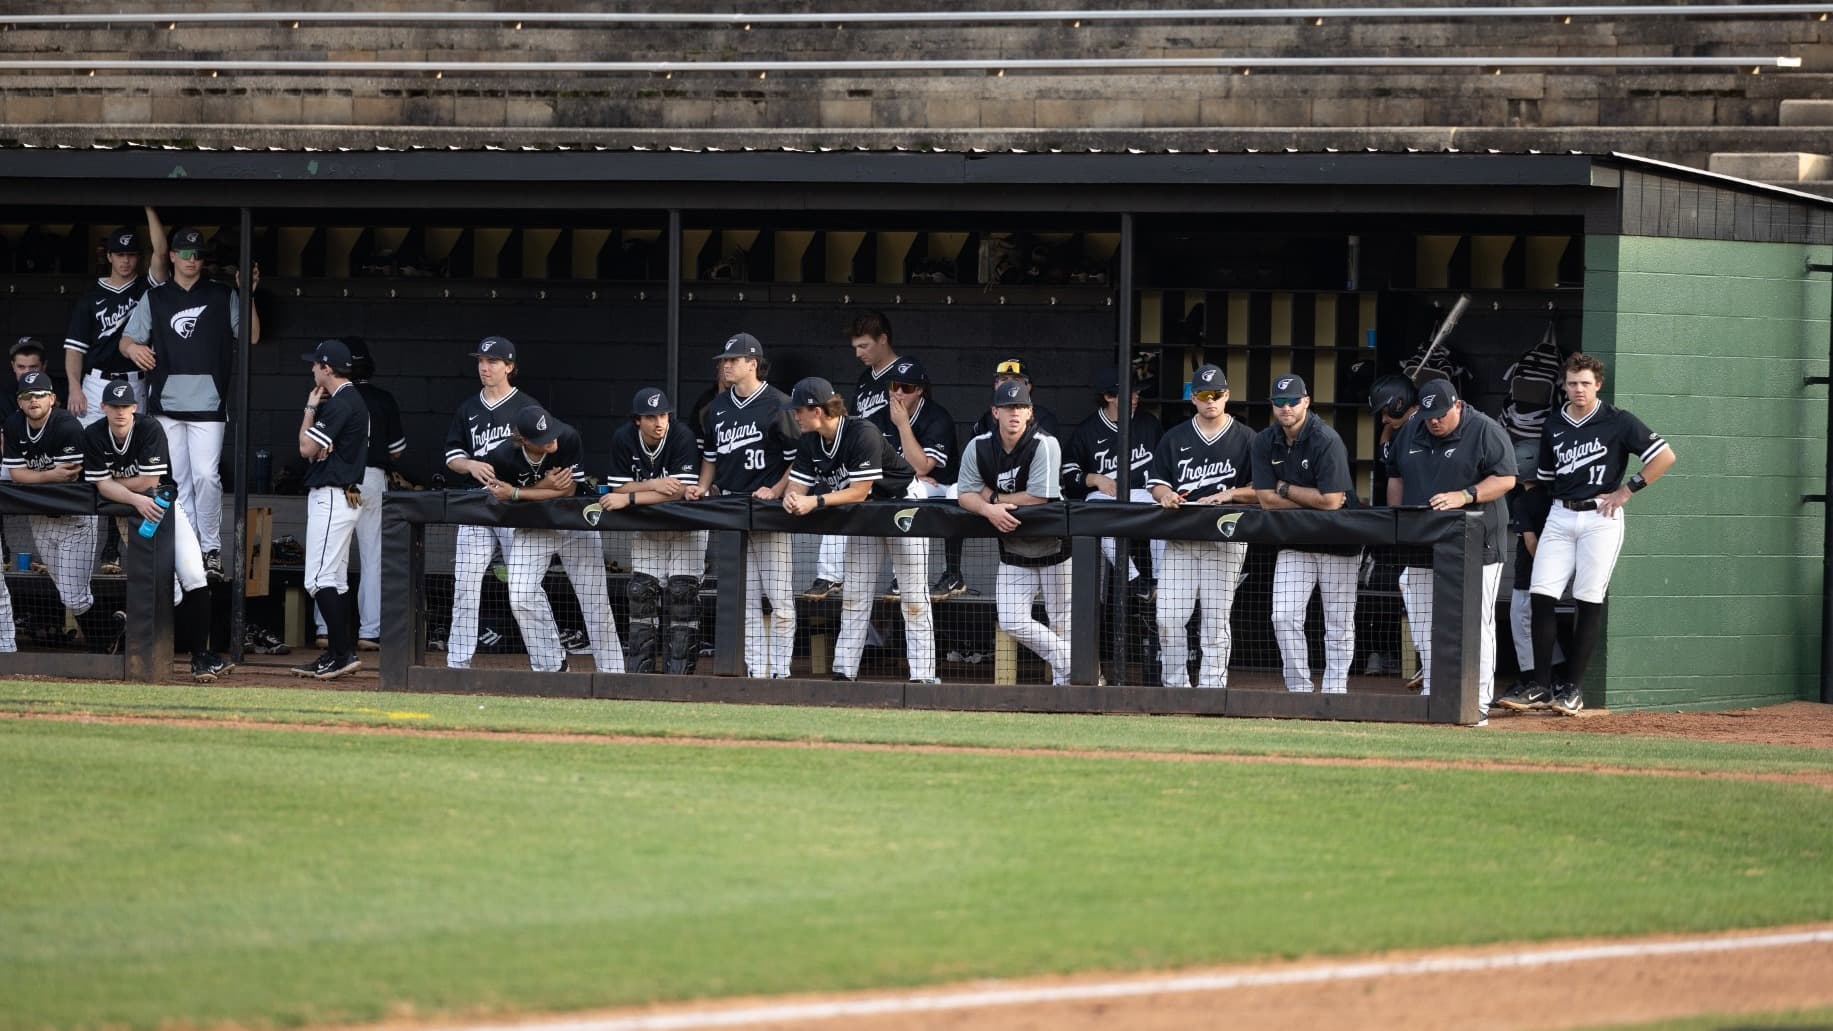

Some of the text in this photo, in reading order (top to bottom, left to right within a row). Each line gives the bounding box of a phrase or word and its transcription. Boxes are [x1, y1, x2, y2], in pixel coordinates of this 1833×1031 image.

[470, 422, 512, 456] Trojans
[715, 420, 763, 454] Trojans
[744, 449, 766, 469] 30
[1094, 443, 1153, 480] Trons
[1553, 437, 1608, 475] Trojans
[1177, 457, 1237, 492] Trojans
[1587, 464, 1607, 485] 17
